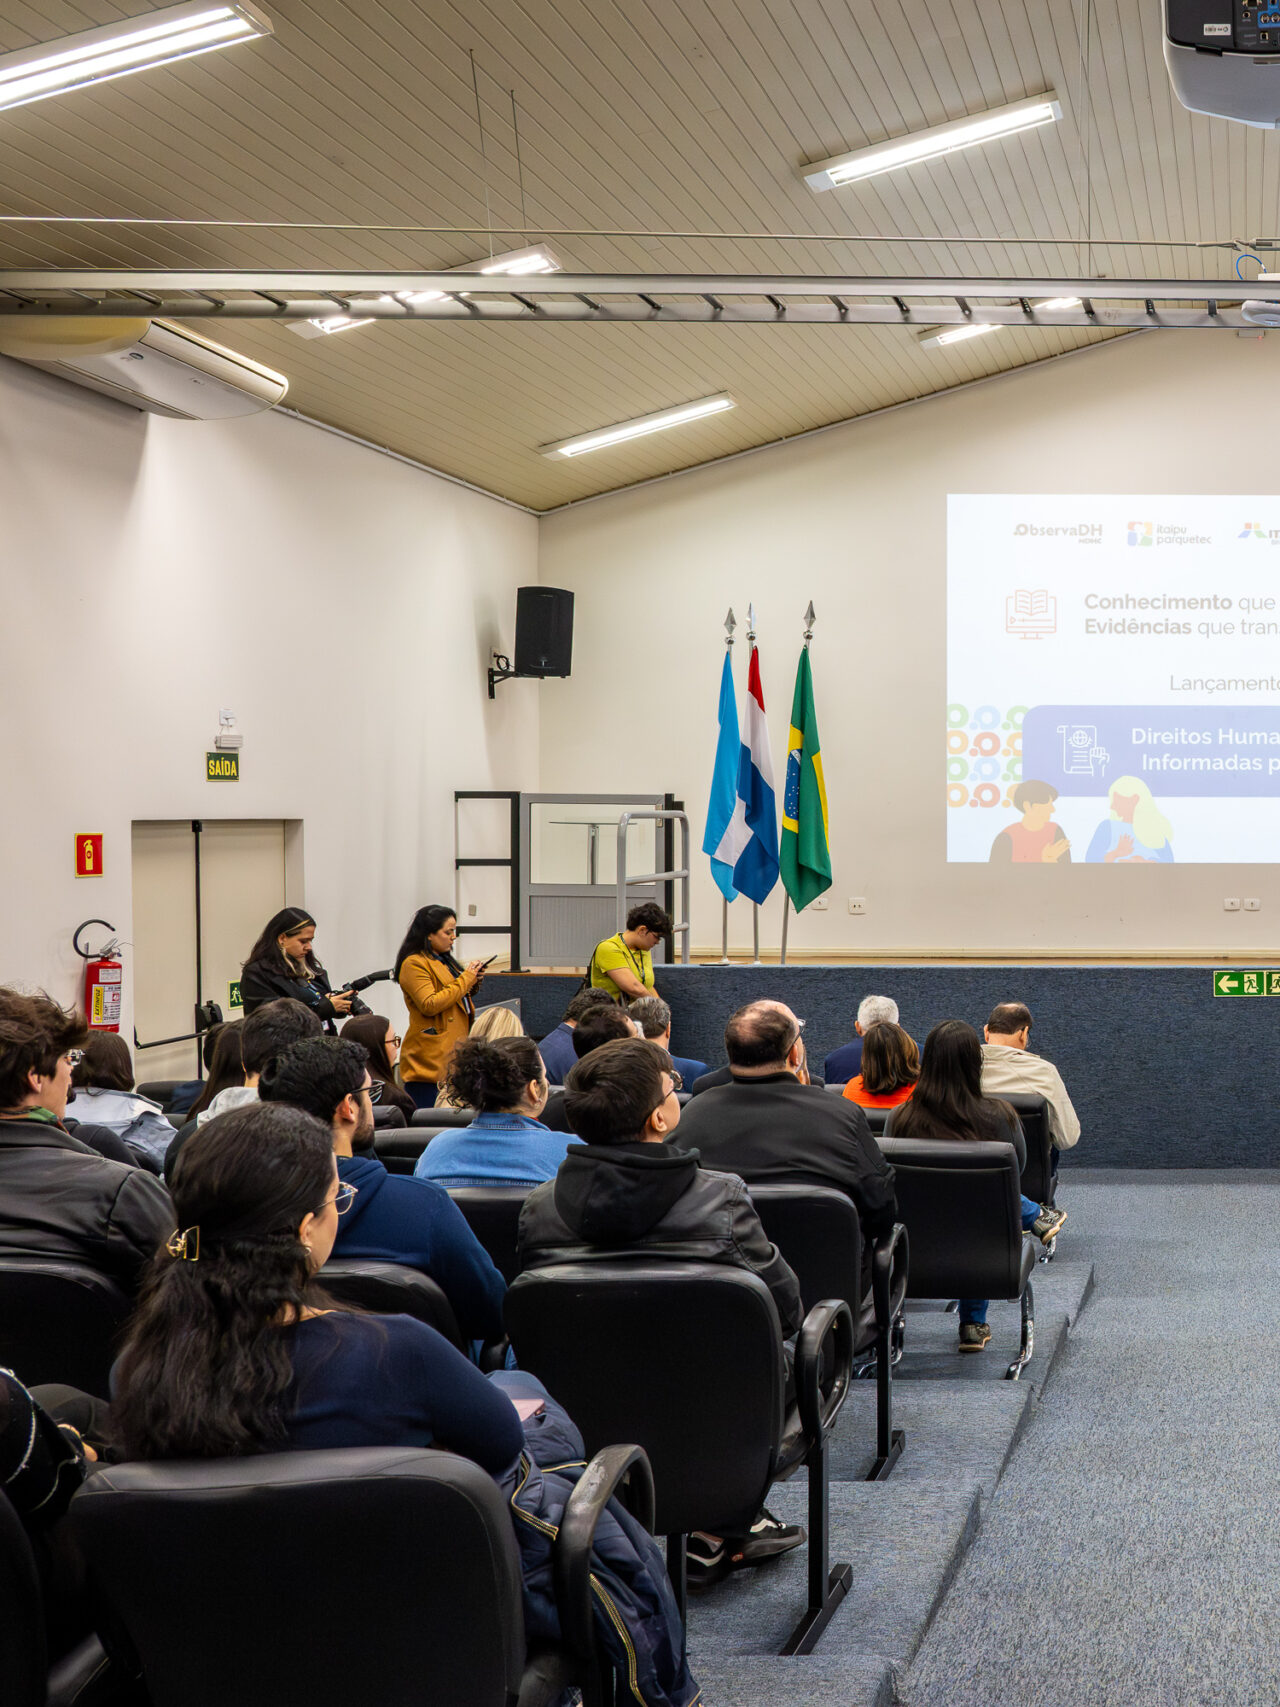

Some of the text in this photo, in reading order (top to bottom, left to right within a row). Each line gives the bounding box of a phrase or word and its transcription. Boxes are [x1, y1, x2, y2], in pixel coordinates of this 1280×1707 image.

[1013, 523, 1103, 537] ObservaDH
[1156, 523, 1187, 535] itaipu
[1156, 534, 1212, 546] parquetec
[1084, 593, 1233, 611] Conhecimento
[1239, 597, 1276, 614] que
[1084, 617, 1192, 635] Evidências
[1197, 622, 1236, 638] que
[1131, 727, 1212, 745] Direitos
[208, 757, 237, 777] SAÍDA
[1142, 752, 1263, 771] Informadas
